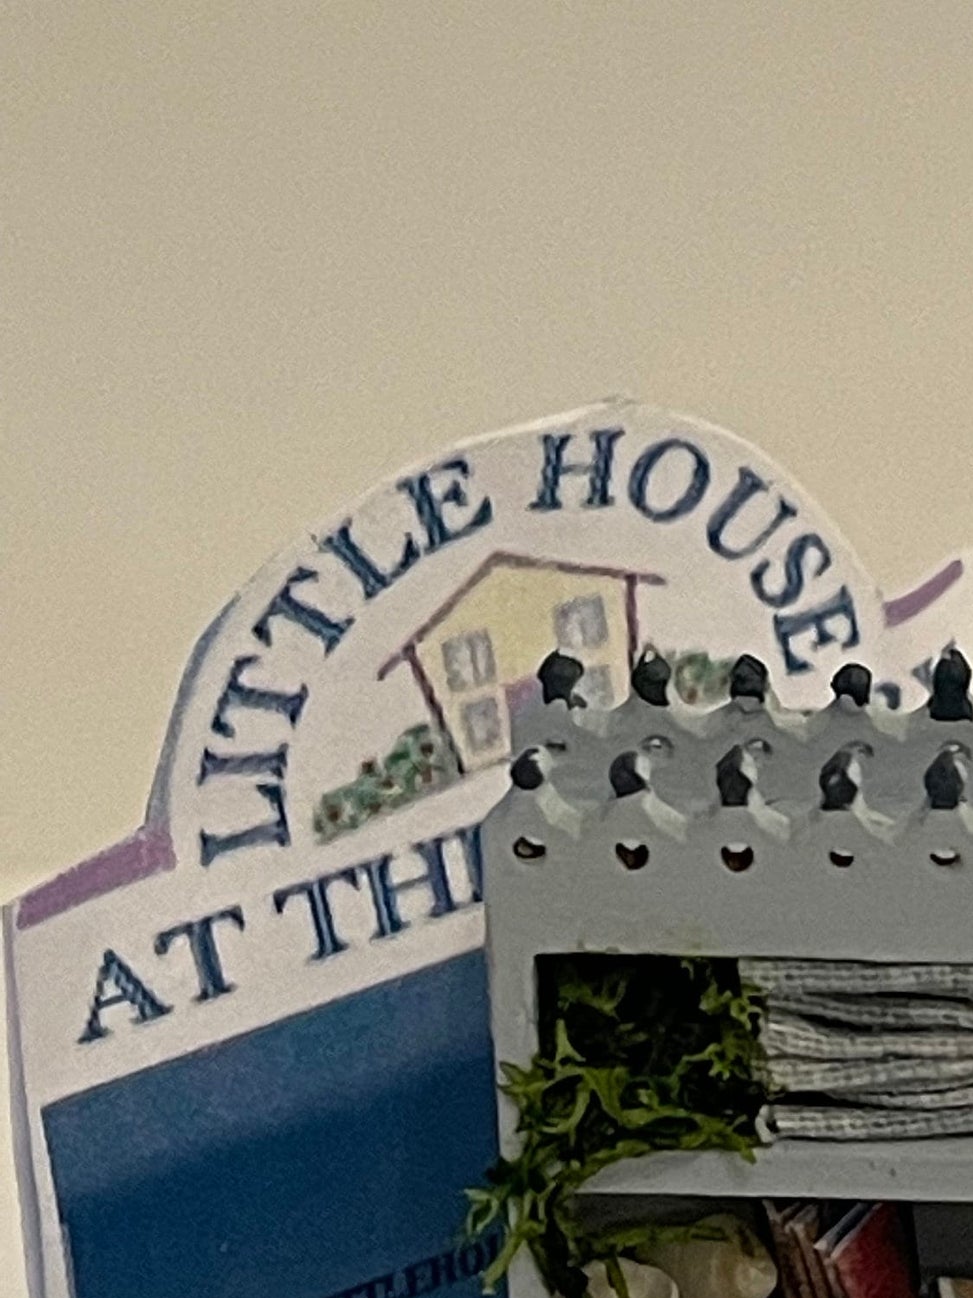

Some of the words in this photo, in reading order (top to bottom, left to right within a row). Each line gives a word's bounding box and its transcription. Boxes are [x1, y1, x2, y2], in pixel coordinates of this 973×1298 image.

[198, 455, 493, 867] LITTLE
[525, 428, 860, 676] HOUSE
[78, 905, 245, 1044] AT
